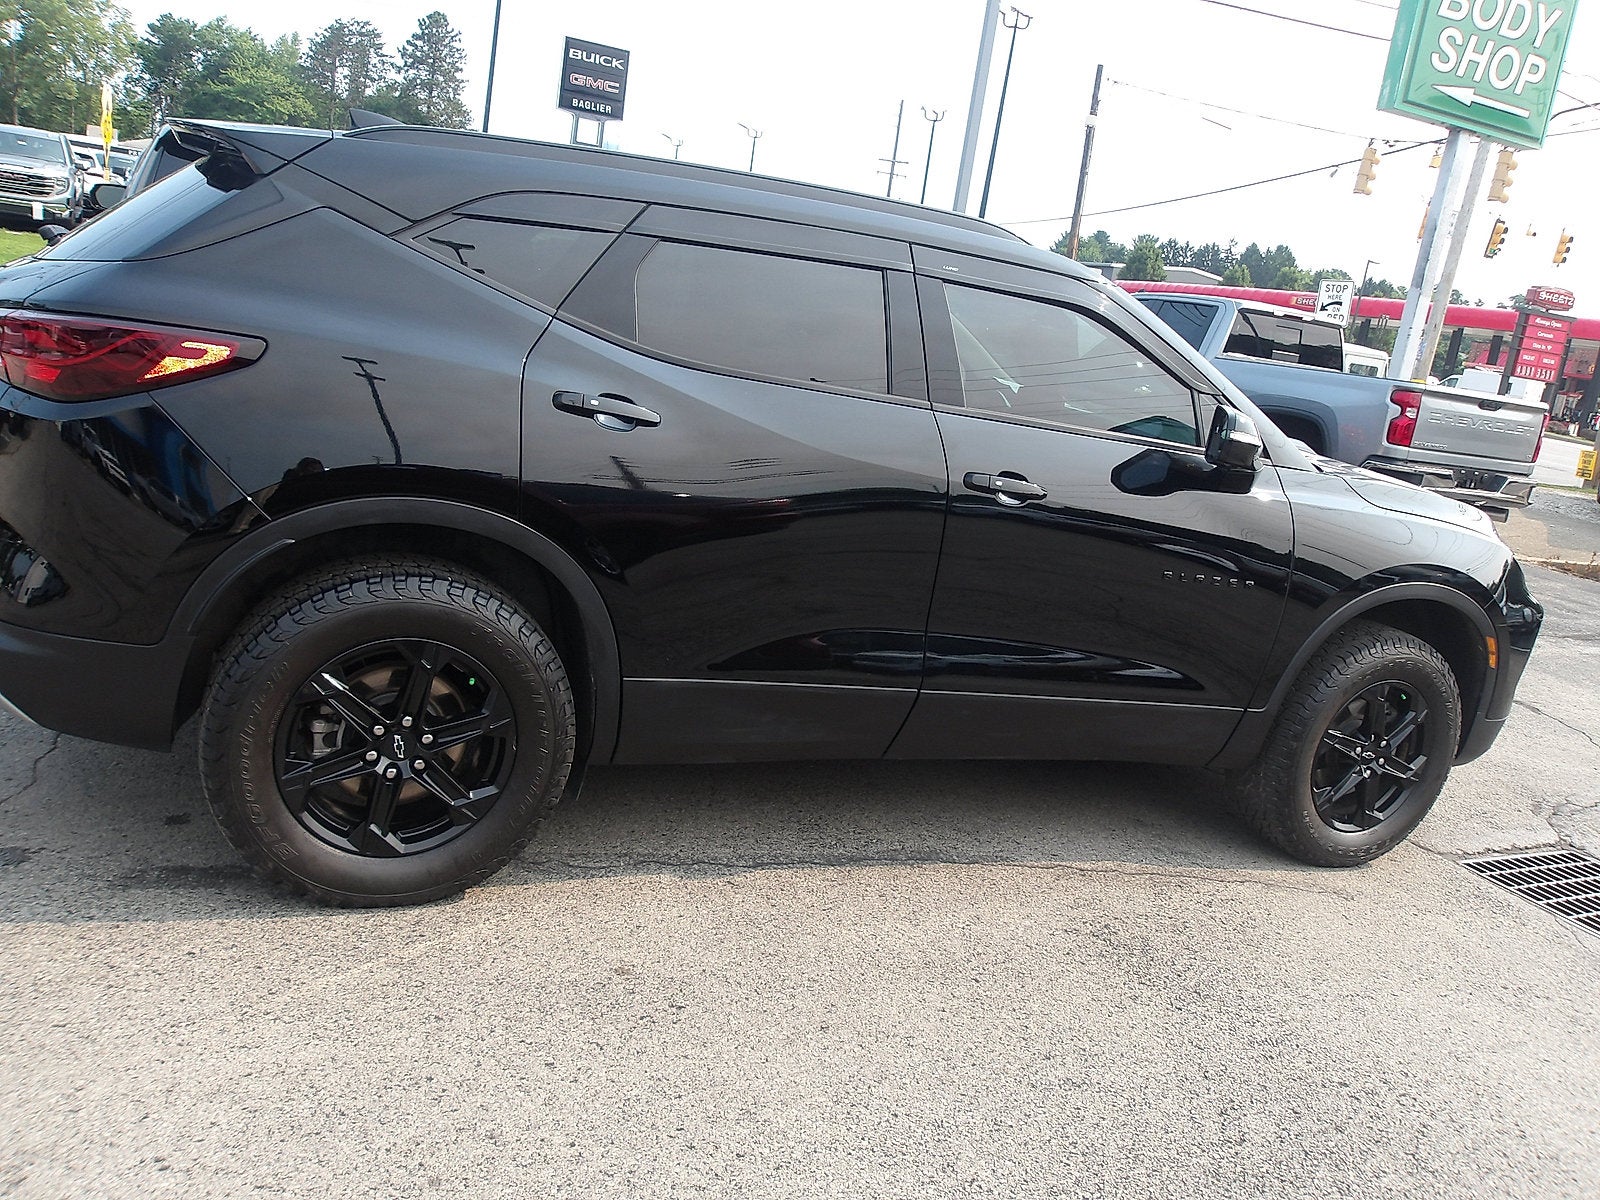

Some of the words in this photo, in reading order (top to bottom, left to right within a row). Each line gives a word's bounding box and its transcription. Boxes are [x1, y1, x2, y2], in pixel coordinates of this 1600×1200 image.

[569, 49, 625, 70] BUICK
[1430, 26, 1548, 96] SHOP
[570, 73, 620, 93] GMC
[572, 98, 611, 114] BAGLIER
[1325, 284, 1348, 292] STOP
[1297, 298, 1315, 306] SHE
[1539, 292, 1574, 305] SHEETZ
[1427, 411, 1536, 437] CHEVROLET
[1163, 571, 1255, 588] BLAZER
